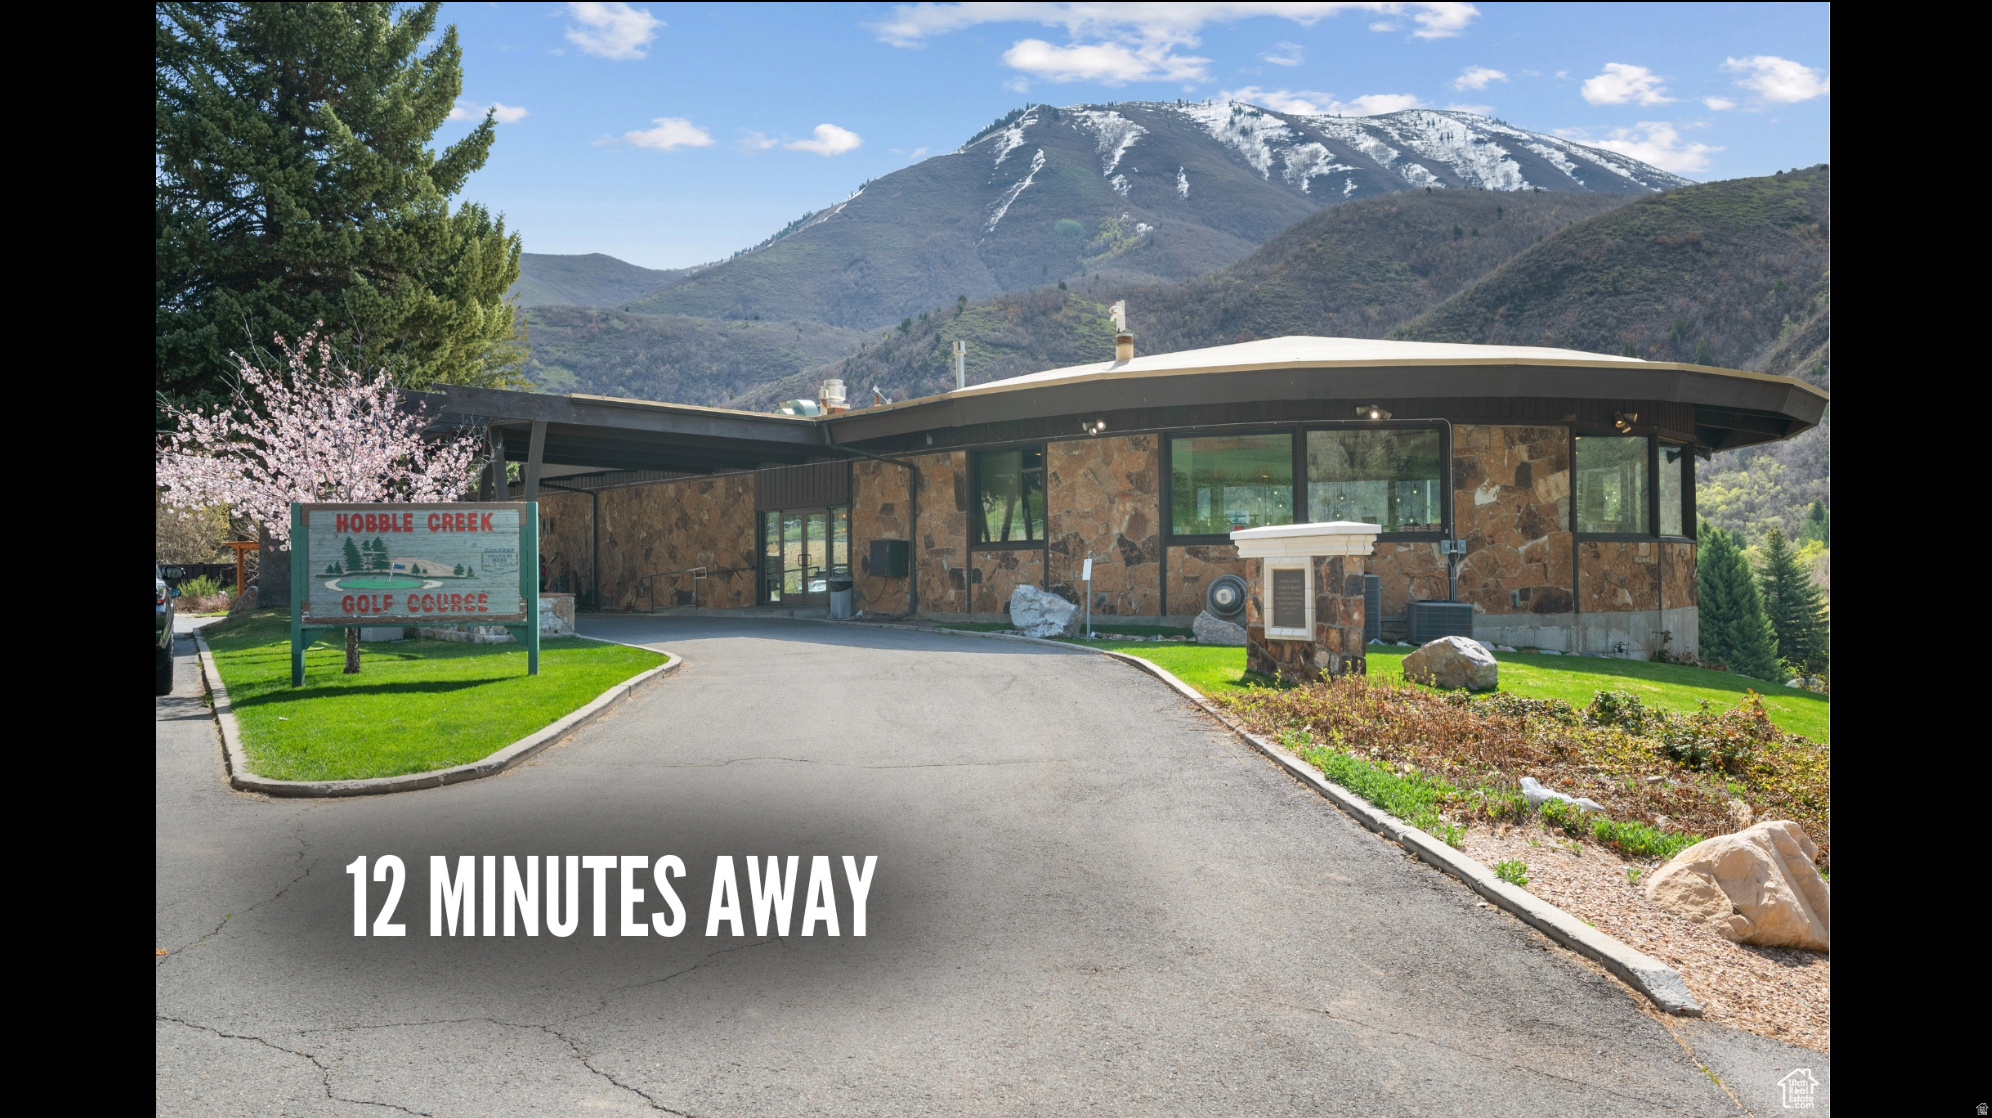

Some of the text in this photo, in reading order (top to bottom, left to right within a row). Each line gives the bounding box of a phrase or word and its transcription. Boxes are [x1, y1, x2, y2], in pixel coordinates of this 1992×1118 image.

[336, 512, 494, 533] HOBBLE CREEK
[342, 593, 489, 613] GOLF COURSE
